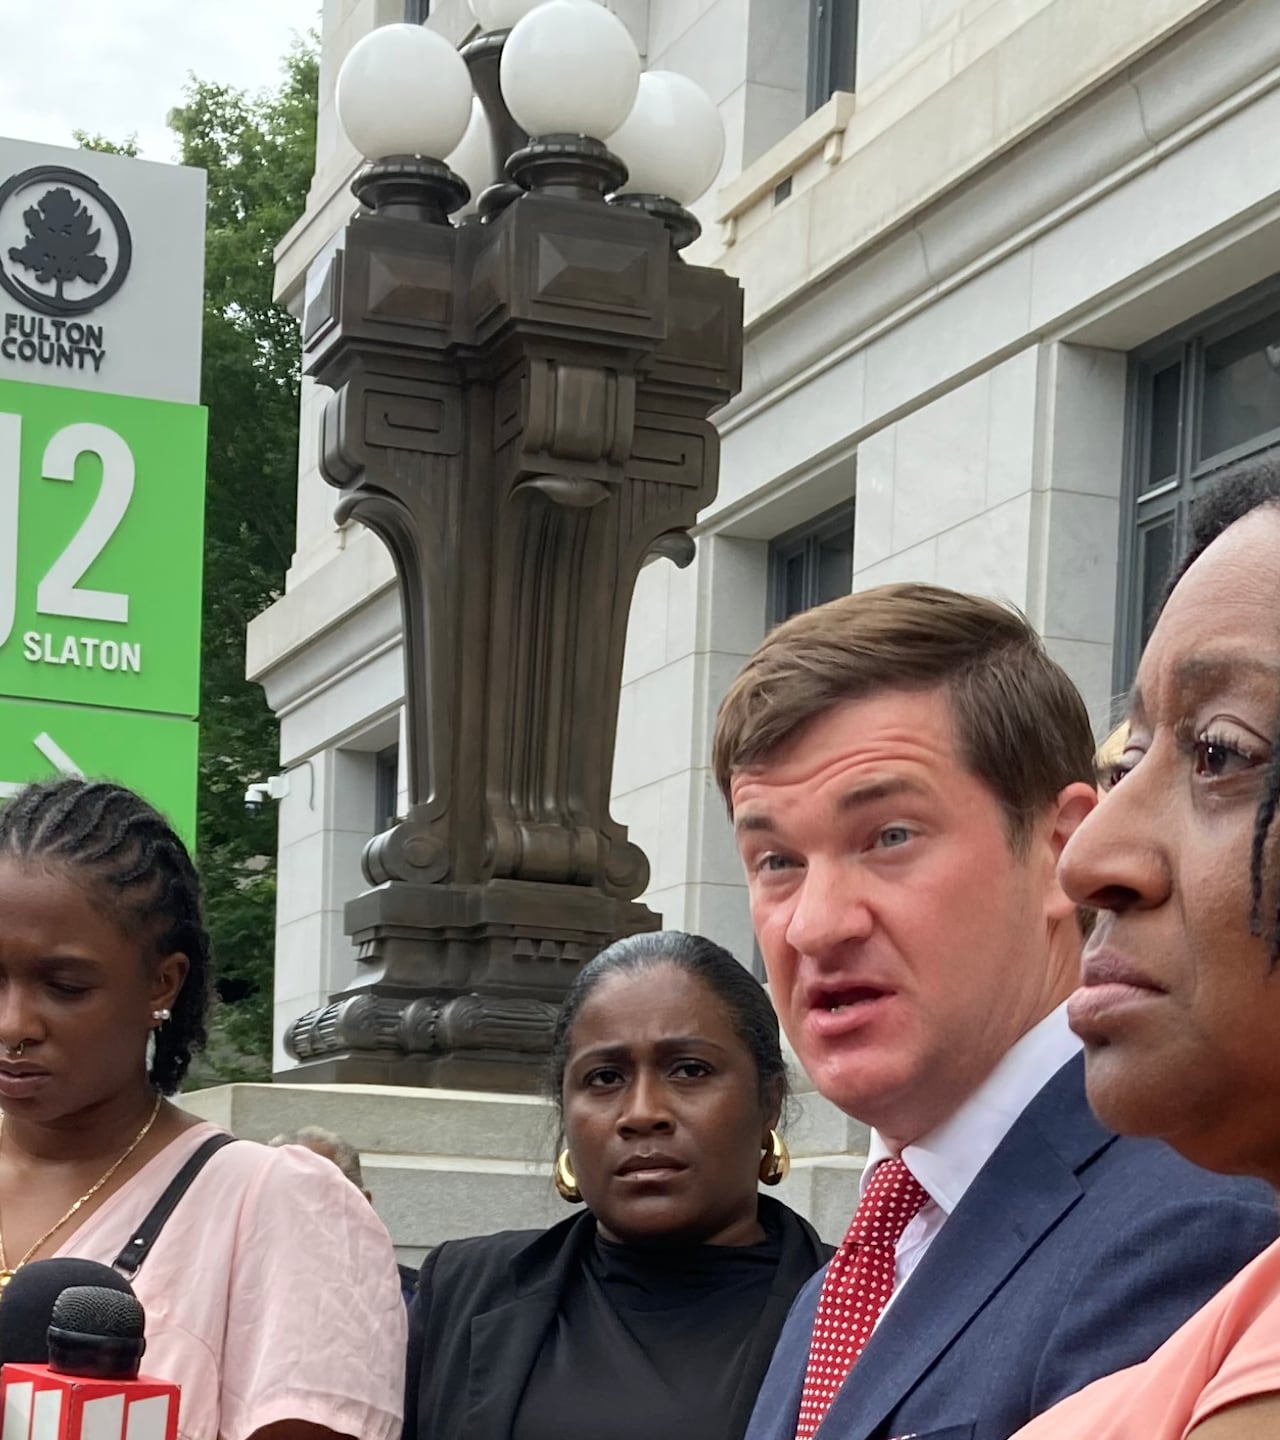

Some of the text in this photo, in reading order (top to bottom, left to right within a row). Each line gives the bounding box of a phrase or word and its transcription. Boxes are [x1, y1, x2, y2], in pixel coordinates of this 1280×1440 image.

[4, 313, 104, 349] FULTON
[1, 337, 106, 372] COUNTY
[23, 631, 141, 673] SLATON
